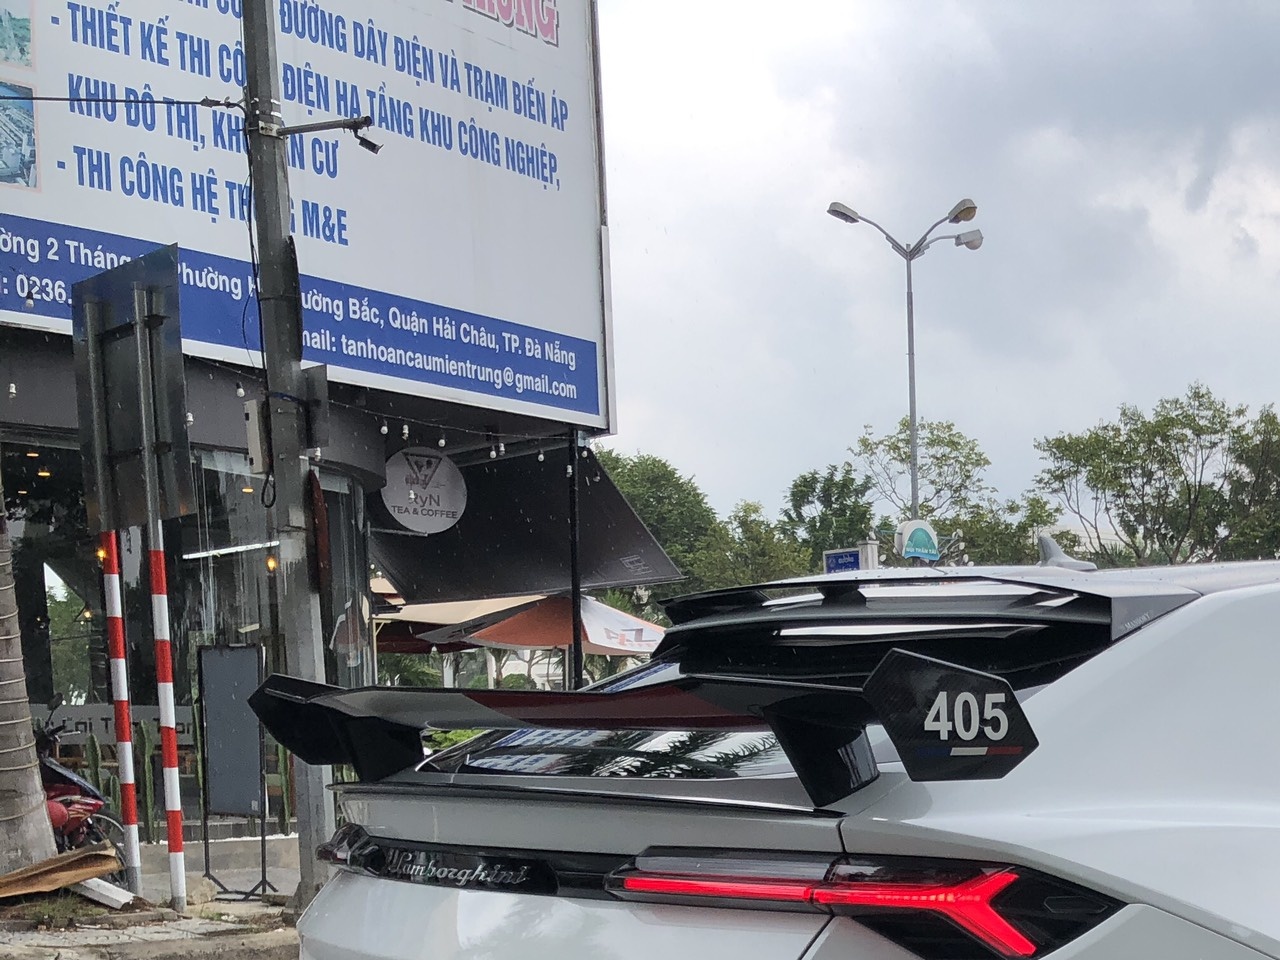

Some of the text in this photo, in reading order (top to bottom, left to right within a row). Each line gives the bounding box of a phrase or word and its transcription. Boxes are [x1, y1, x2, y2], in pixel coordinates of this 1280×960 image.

[67, 1, 132, 56] THIẾT
[140, 15, 169, 67] KẾ
[175, 31, 211, 78] THI
[218, 40, 248, 87] CÔ
[282, 62, 330, 116] ĐIỆN
[366, 81, 414, 139] TẦNG
[419, 107, 452, 150] KHU
[458, 117, 501, 167] CÔNG
[505, 136, 560, 191] NGHIỆP,
[353, 18, 388, 67] DÂY
[394, 35, 435, 87] ĐIỆN
[439, 49, 461, 93] VÀ
[464, 62, 508, 112] TRẠM
[512, 77, 547, 125] BIẾN
[551, 90, 569, 131] ÁP
[68, 72, 117, 123] KHU
[124, 83, 156, 132] ĐÔ
[162, 96, 206, 151] THỊ,
[311, 137, 339, 180] CƯ
[73, 146, 112, 191] THI
[120, 152, 184, 208] CÔNG
[191, 168, 220, 224] HỆ
[301, 199, 349, 246] M&E
[0, 227, 39, 263] ờng
[47, 237, 59, 260] 2
[301, 289, 344, 322] ường
[349, 297, 385, 329] Bắc,
[389, 306, 429, 337] Quận
[432, 315, 457, 341] Hải
[460, 322, 500, 354] Châu,
[502, 331, 522, 355] TP.
[525, 337, 542, 360] Đà
[545, 339, 577, 371] Nẵng
[302, 328, 337, 353] mail:
[341, 333, 577, 400] tanhoancaumientrung@gmail.com
[391, 505, 410, 515] TEA
[421, 508, 458, 518] COFFEE
[924, 691, 1008, 741] 405
[388, 851, 530, 887] Lamborghini
